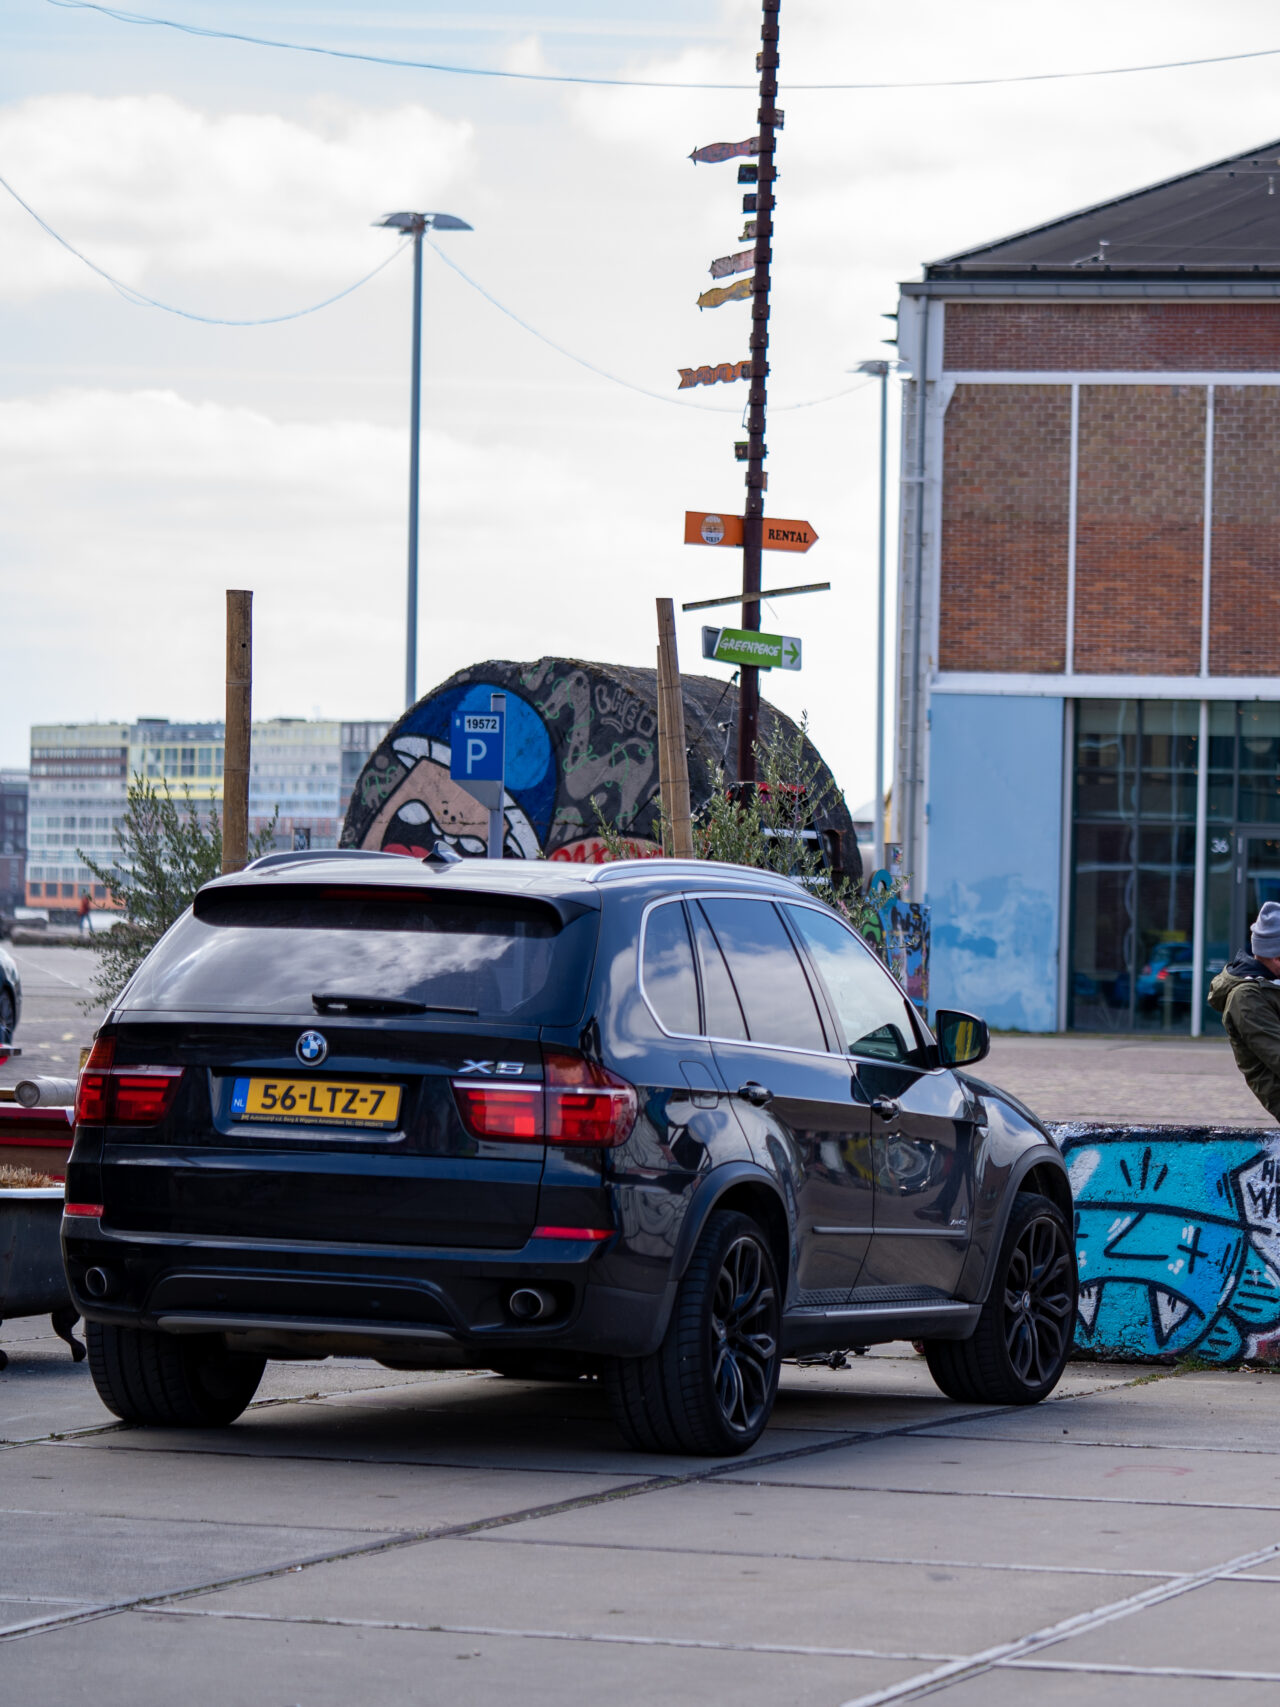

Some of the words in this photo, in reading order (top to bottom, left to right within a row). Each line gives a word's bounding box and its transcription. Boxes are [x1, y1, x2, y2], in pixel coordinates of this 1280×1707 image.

[768, 528, 810, 544] RENTAL
[720, 636, 782, 658] GREENPEACE
[466, 718, 498, 730] 19572
[466, 738, 488, 775] P
[1211, 837, 1230, 853] 36
[458, 1059, 525, 1076] X5
[234, 1099, 244, 1108] NL
[261, 1083, 387, 1116] 56-LTZ-7
